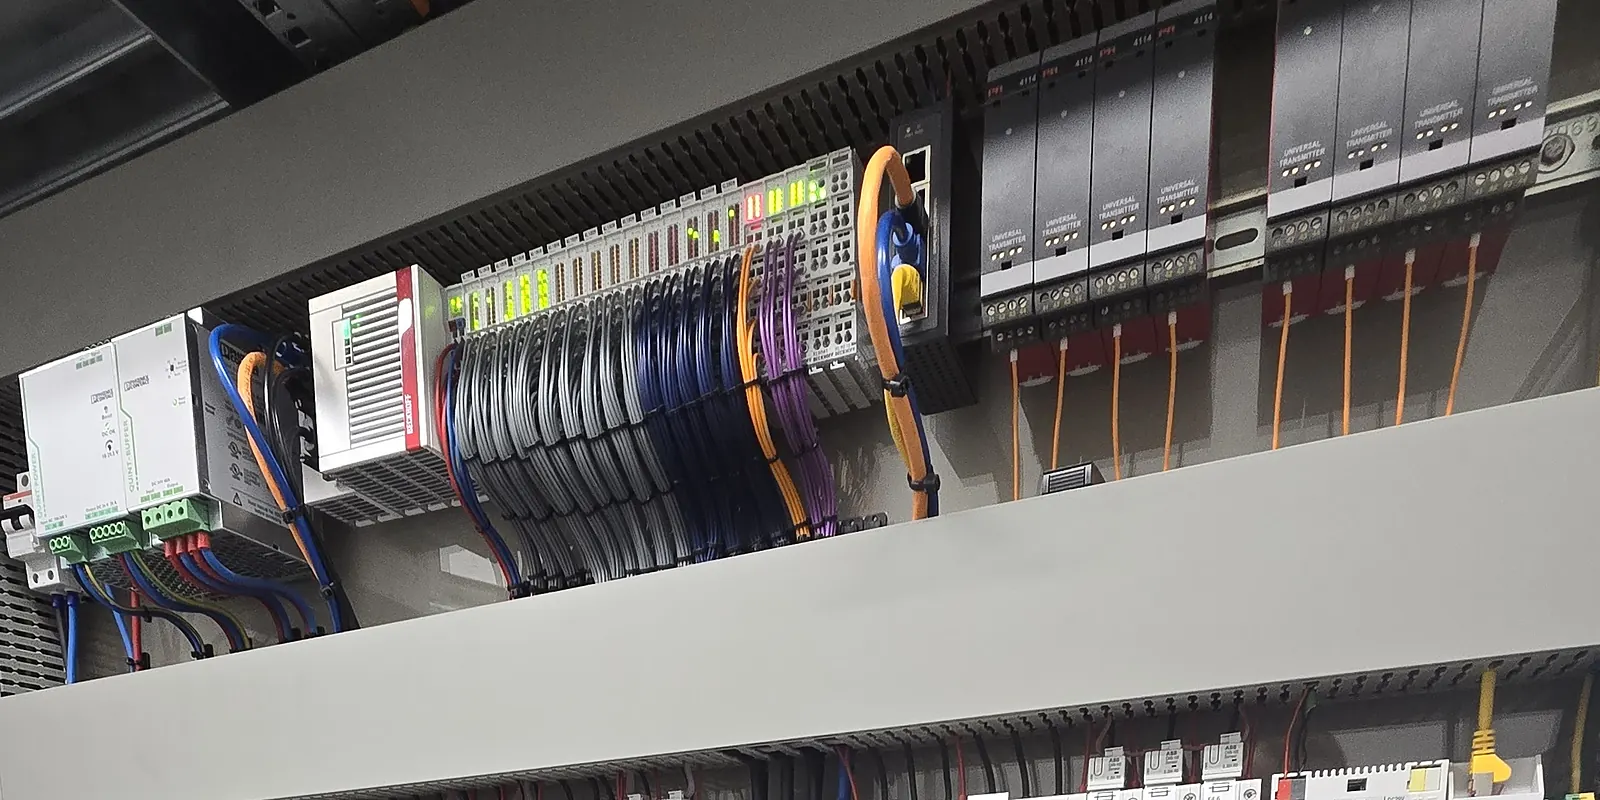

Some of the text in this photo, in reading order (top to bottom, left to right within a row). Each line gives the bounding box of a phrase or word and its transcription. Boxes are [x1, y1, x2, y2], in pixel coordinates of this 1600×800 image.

[1194, 12, 1212, 24] 4114
[1133, 34, 1152, 46] 4114
[1075, 54, 1092, 67] 4114
[1020, 73, 1036, 86] 4114
[1283, 140, 1322, 157] UNIVERSAL
[1280, 148, 1326, 168] TRANSMITTER
[1160, 178, 1195, 194] UNIVERSAL
[1102, 195, 1136, 210] UNIVERSAL
[1157, 186, 1199, 204] TRANSMITTER
[1099, 202, 1140, 220] TRANSMITTER
[1042, 220, 1081, 236] TRANSMITTER
[1046, 213, 1078, 228] UNIVERSAL
[988, 235, 1026, 252] TRANSMITTER
[992, 229, 1022, 242] UNIVERSAL
[405, 394, 414, 434] BECKHOFF
